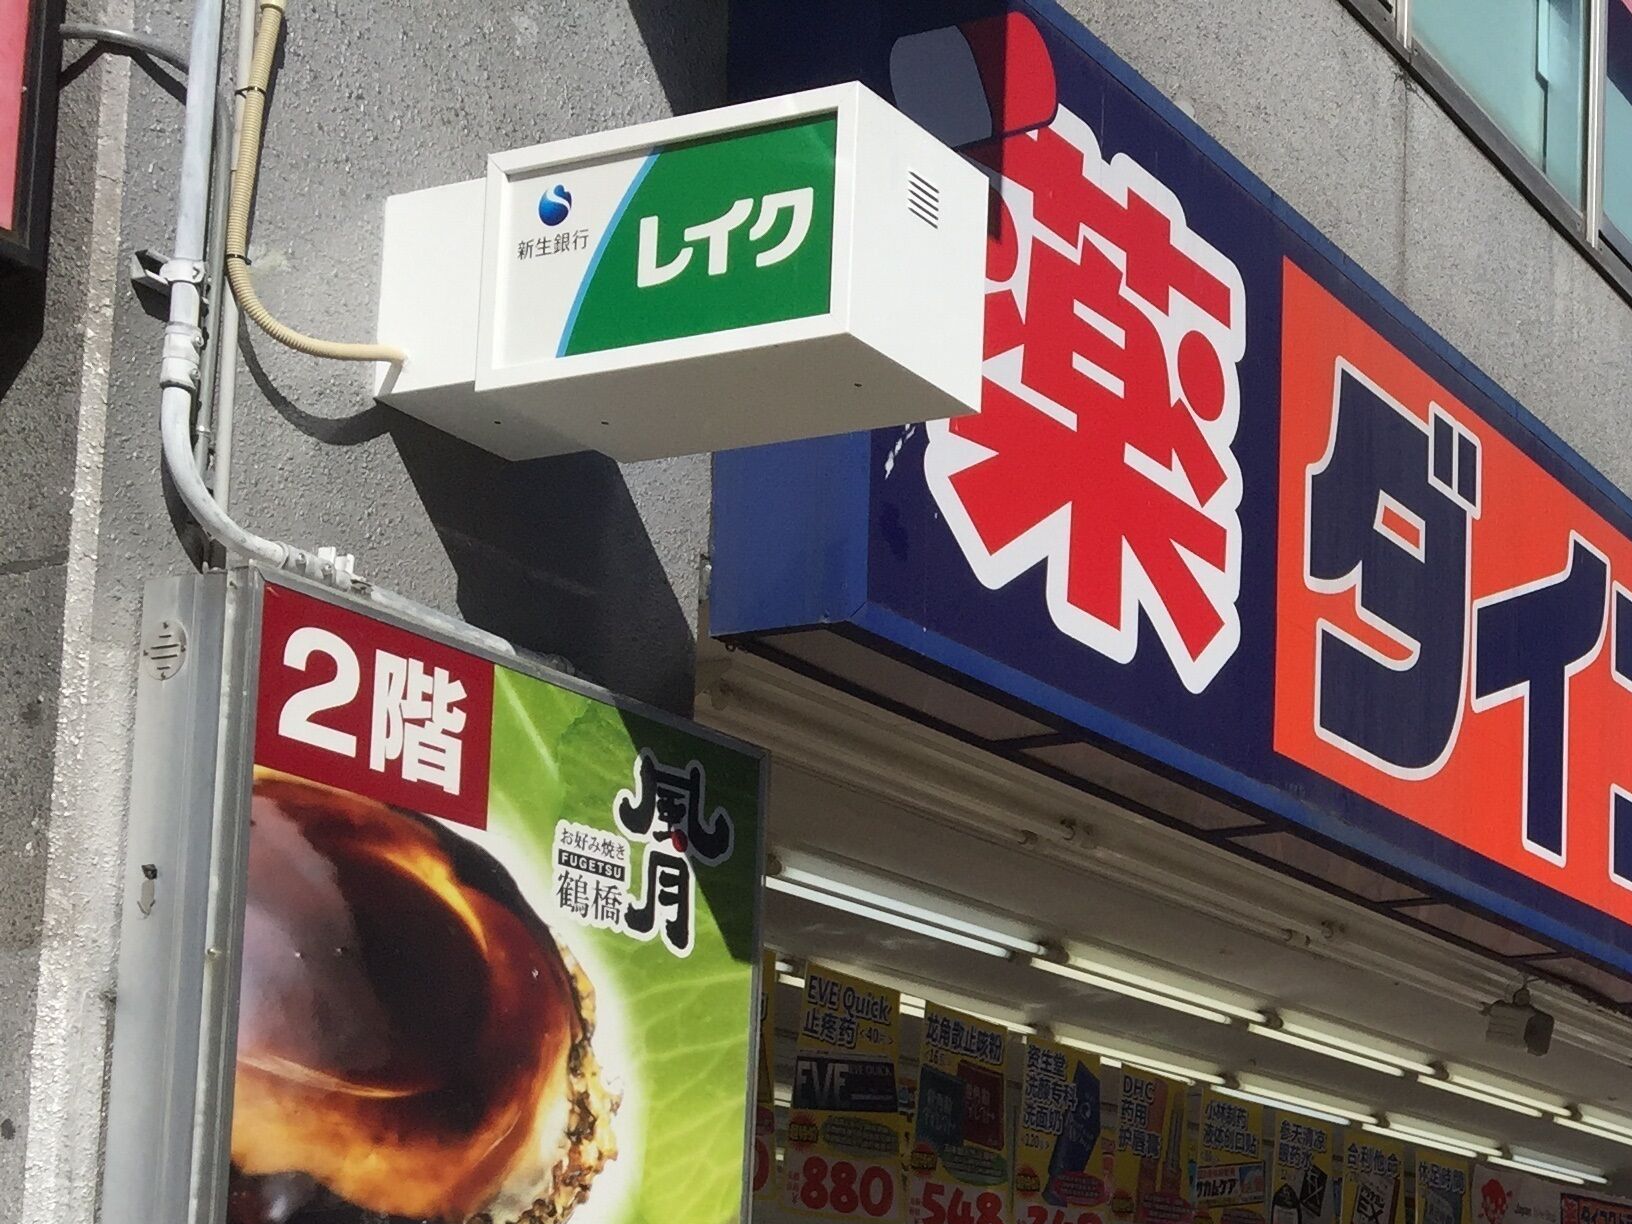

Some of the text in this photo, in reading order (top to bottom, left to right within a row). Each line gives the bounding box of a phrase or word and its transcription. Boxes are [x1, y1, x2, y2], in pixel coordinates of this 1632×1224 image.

[517, 229, 589, 261] 新生銀行
[637, 187, 814, 289] レイク
[924, 108, 1244, 692] 薬
[278, 626, 467, 795] 2階
[559, 850, 625, 881] FUGETSU
[560, 828, 626, 861] お好み焼き
[616, 749, 734, 957] 風月
[556, 868, 625, 926] 鶴橋
[842, 986, 893, 1023] Quick
[1122, 1075, 1155, 1103] DHC
[800, 1155, 896, 1218] 880
